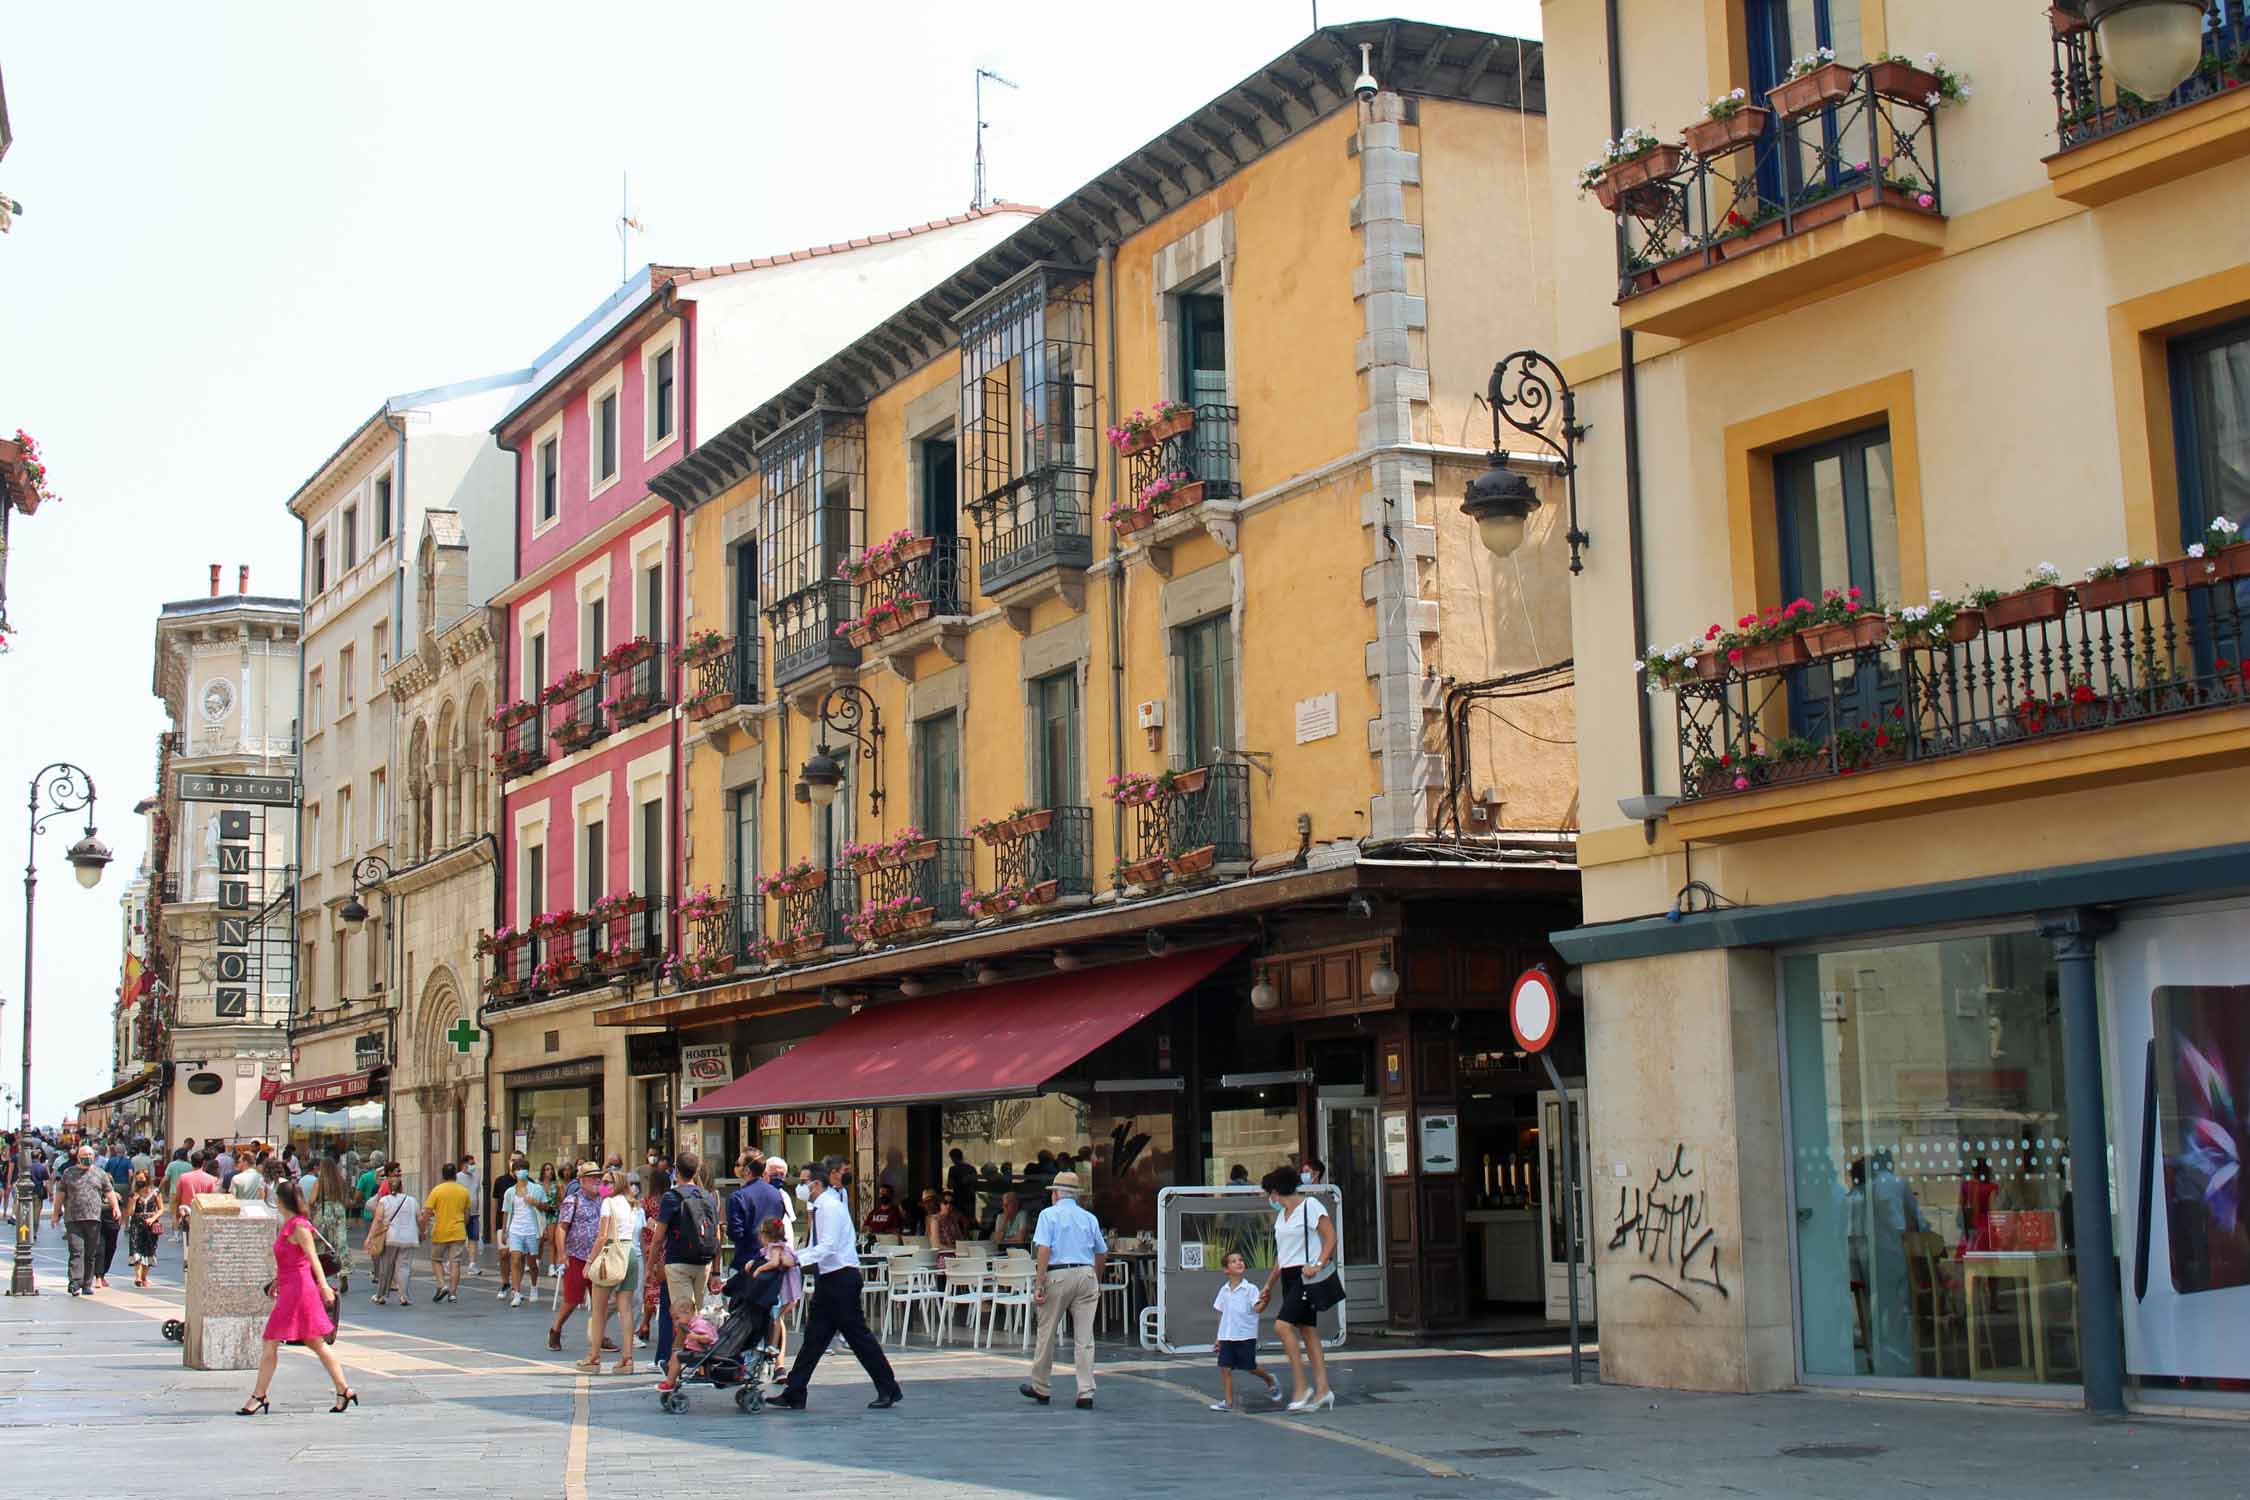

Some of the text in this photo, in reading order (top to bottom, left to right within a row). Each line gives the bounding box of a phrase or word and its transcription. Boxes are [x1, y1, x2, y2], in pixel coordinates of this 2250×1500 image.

[191, 781, 284, 795] zapatos
[222, 848, 248, 1015] MUÑOZ
[686, 1046, 727, 1059] HOSTEL
